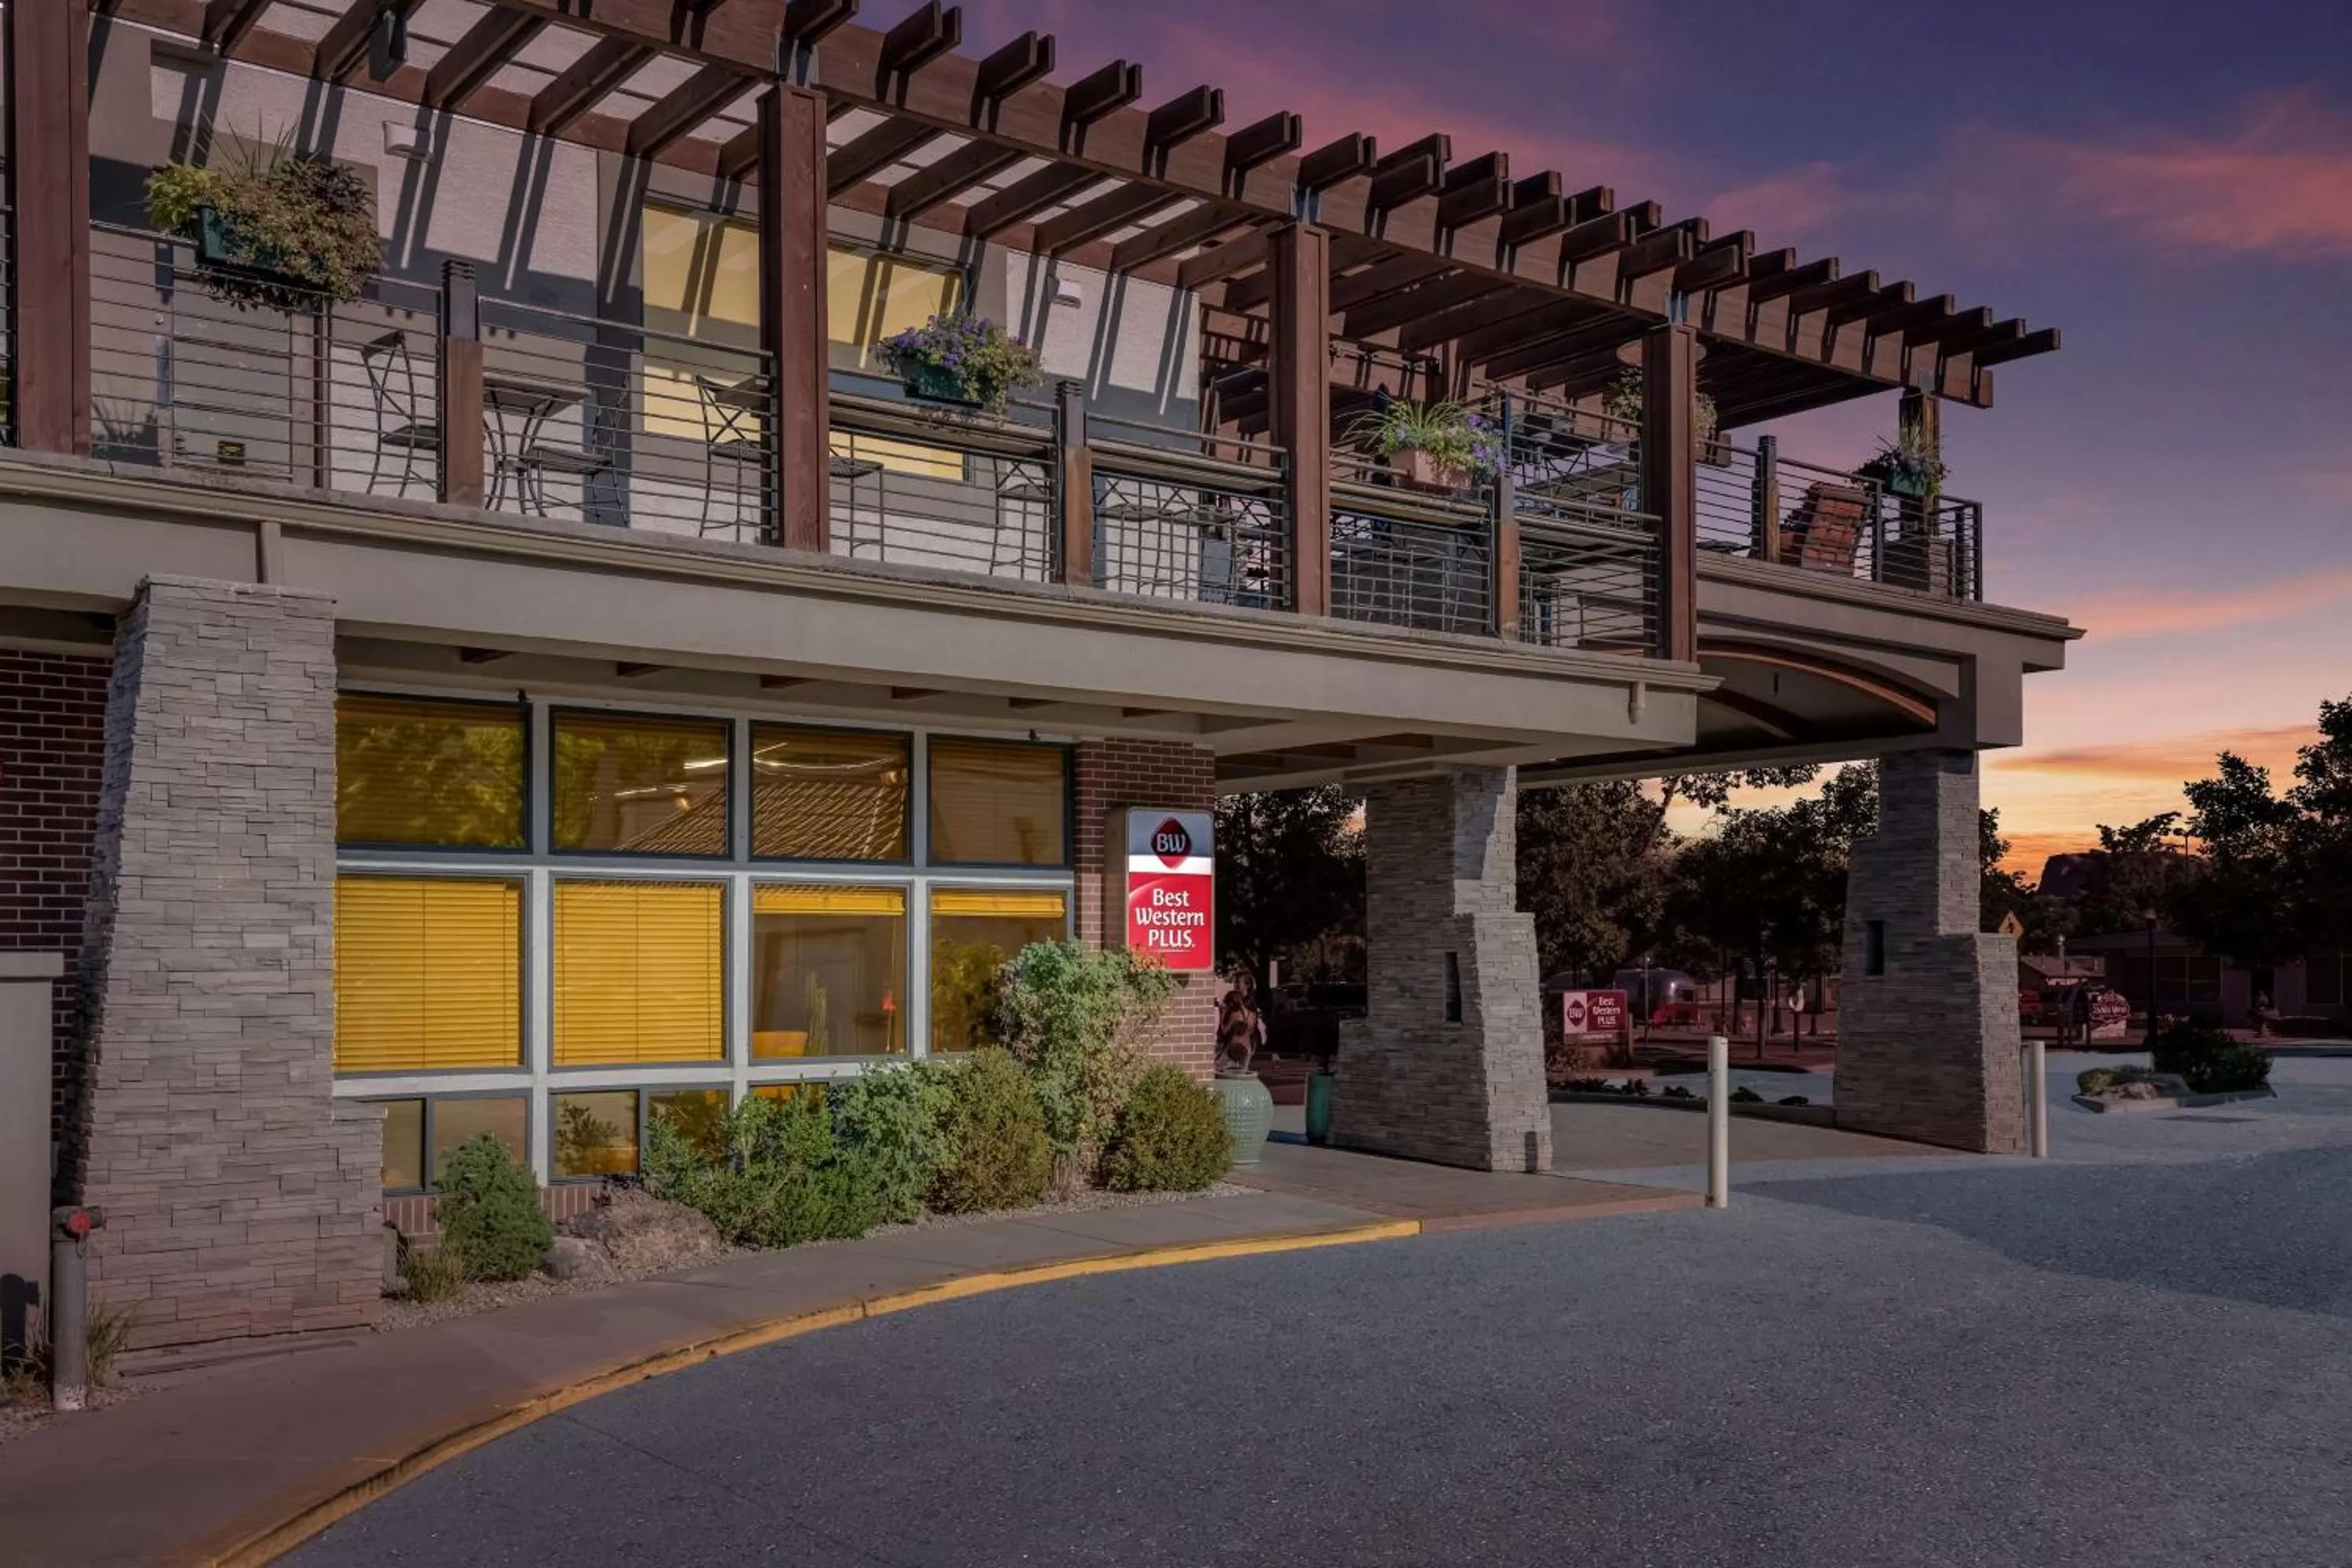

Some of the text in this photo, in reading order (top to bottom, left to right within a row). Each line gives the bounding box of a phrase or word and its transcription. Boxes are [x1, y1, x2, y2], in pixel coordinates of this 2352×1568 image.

[1156, 833, 1186, 853] BW
[1152, 887, 1189, 907] Best
[1135, 907, 1204, 926] Western
[1148, 929, 1193, 948] PLUS
[1597, 1015, 1617, 1025] PLUS
